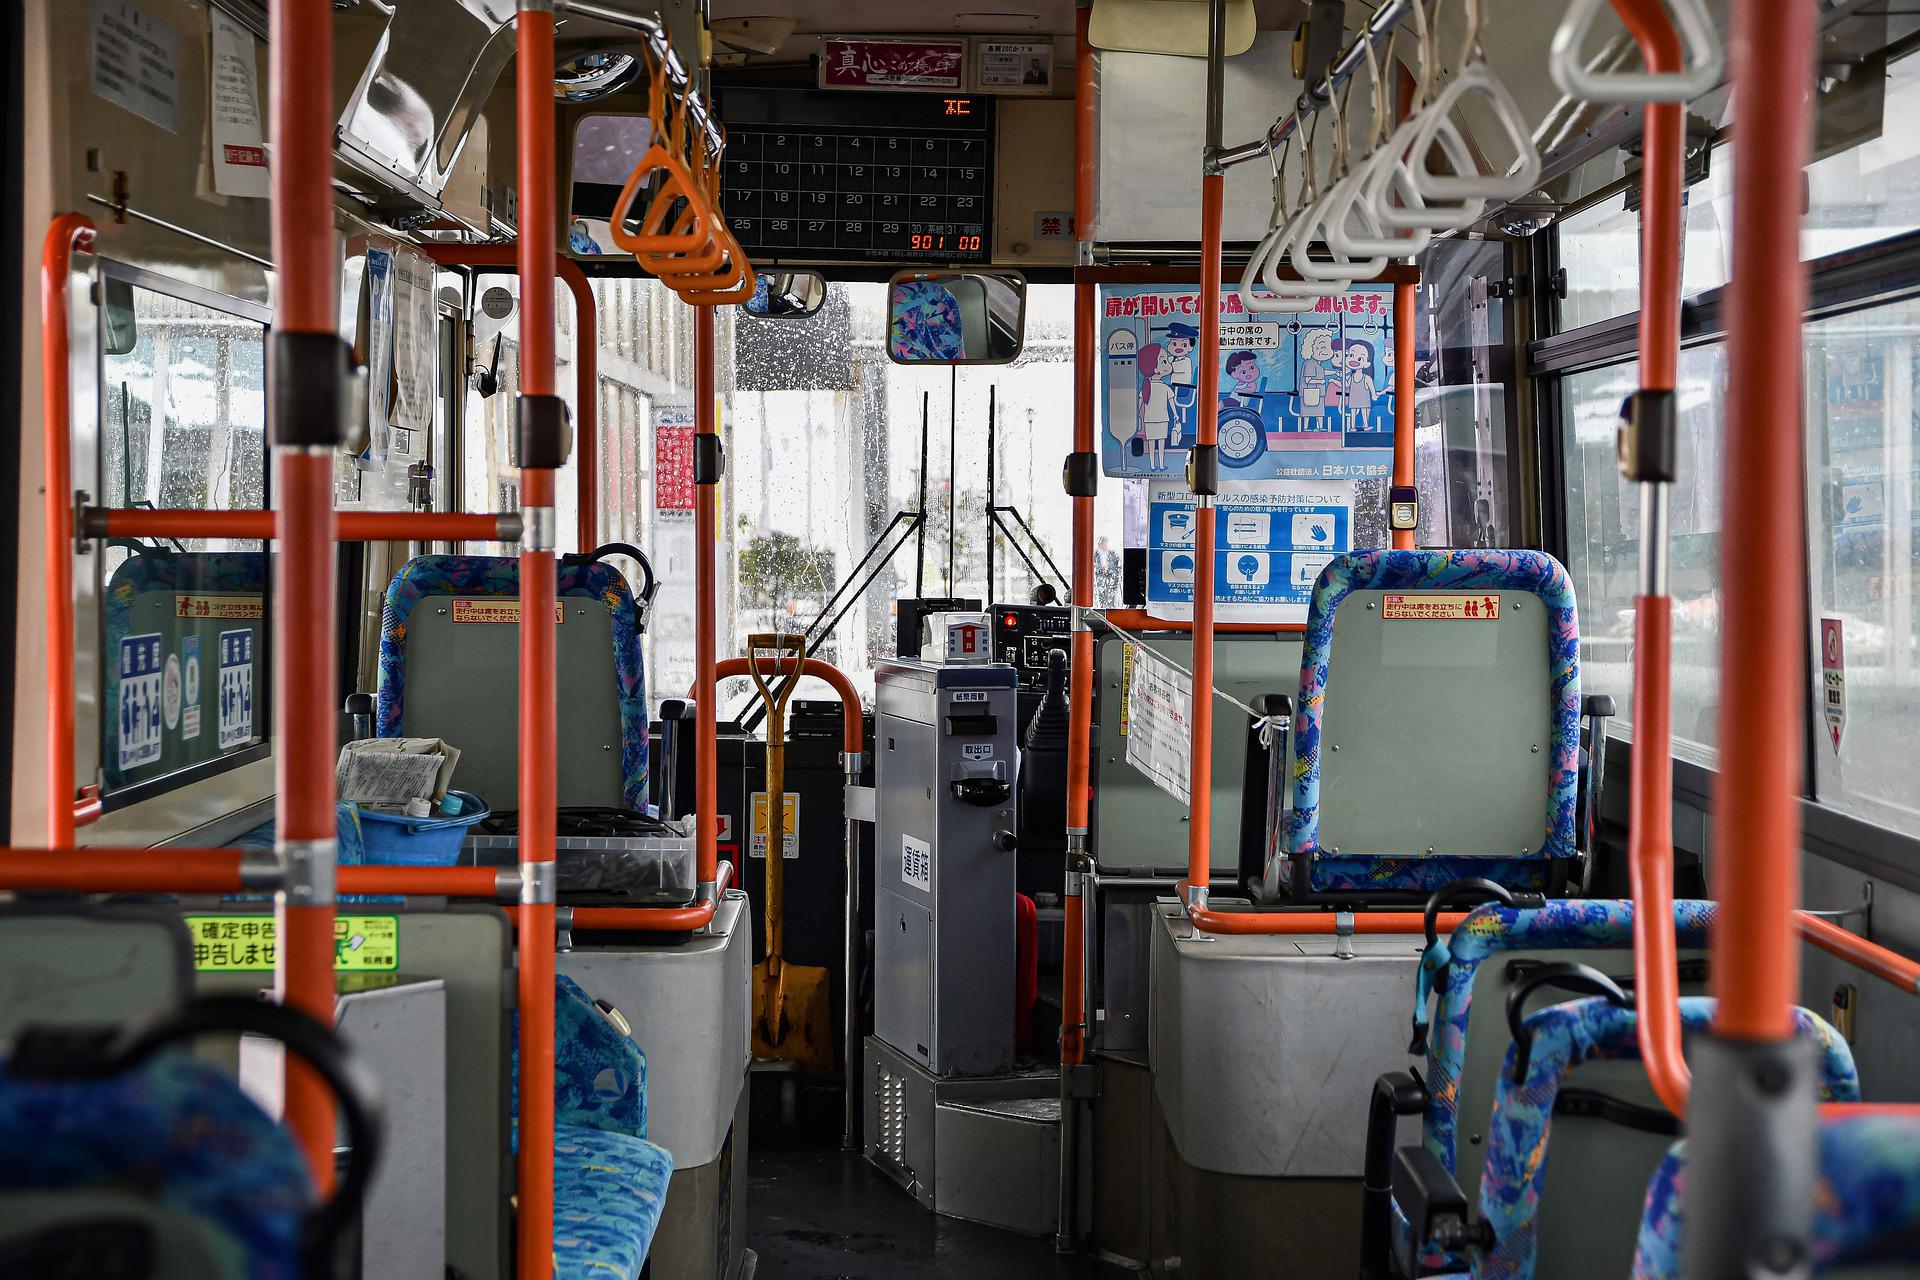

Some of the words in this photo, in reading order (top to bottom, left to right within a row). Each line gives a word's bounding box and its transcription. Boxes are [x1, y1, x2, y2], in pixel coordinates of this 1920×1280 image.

[741, 135, 746, 144] 1
[777, 136, 785, 145] 2
[814, 137, 823, 146] 3
[851, 138, 860, 147] 4
[889, 139, 897, 148] 5
[926, 140, 934, 149] 6
[963, 141, 971, 150] 7
[739, 163, 748, 172] 9
[774, 164, 789, 173] 10
[812, 166, 825, 175] 11
[849, 167, 863, 176] 12
[886, 168, 900, 177] 13
[923, 169, 937, 178] 14
[960, 170, 974, 179] 15
[737, 191, 751, 201] 17
[774, 192, 789, 201] 18
[811, 193, 826, 203] 19
[847, 195, 863, 204] 20
[884, 196, 898, 205] 21
[920, 197, 937, 206] 22
[958, 197, 974, 207] 23
[734, 220, 751, 229] 25
[772, 221, 788, 230] 26
[808, 222, 825, 231] 27
[846, 223, 862, 232] 28
[882, 224, 899, 233] 29
[911, 235, 943, 249] 901
[959, 236, 981, 250] 00
[1219, 326, 1263, 335] 行中の席の
[1219, 337, 1276, 346] 動は危険です。
[1322, 465, 1388, 476] 日本バス協会
[1157, 491, 1341, 504] 新型コロイルスの感染予防対策について
[956, 693, 985, 701] 紙幣両替
[965, 745, 991, 754] 取出口
[904, 845, 929, 882] 運賃箱
